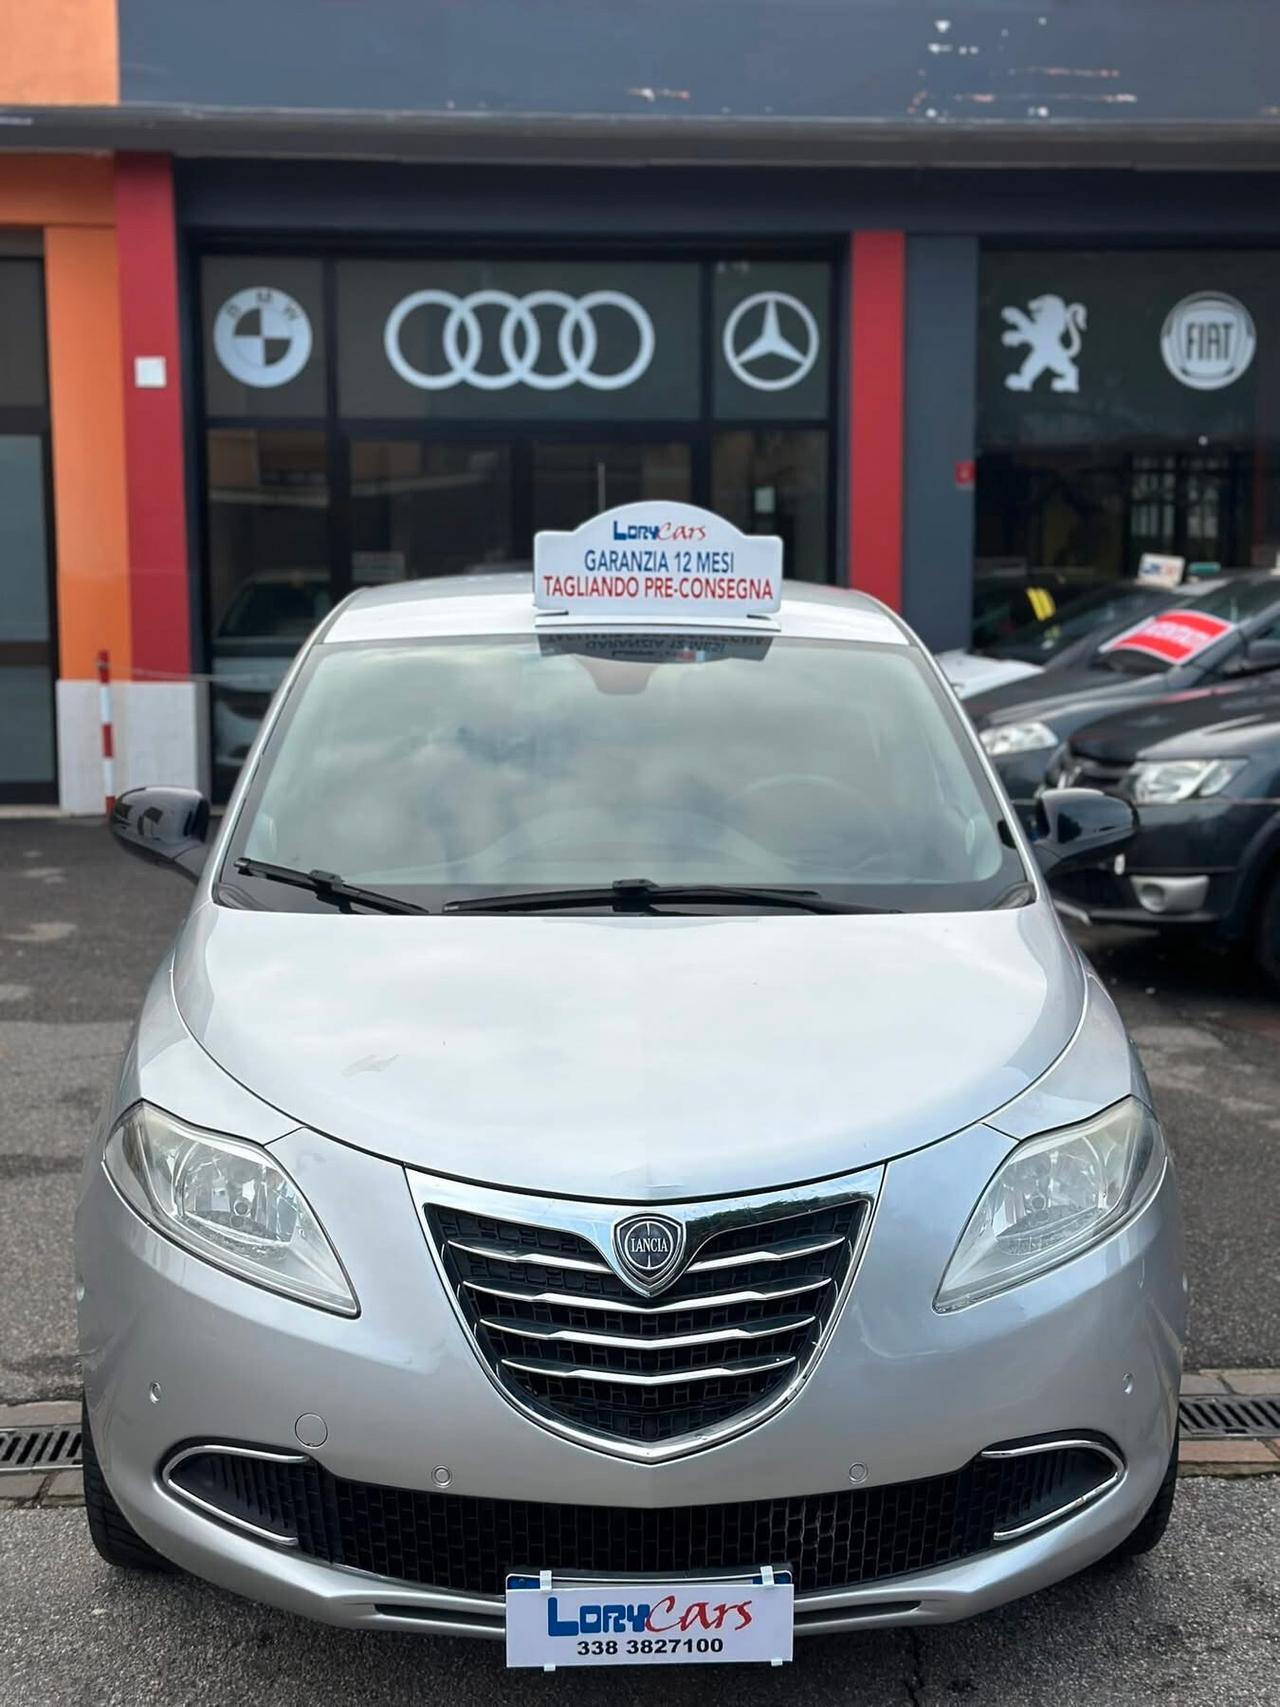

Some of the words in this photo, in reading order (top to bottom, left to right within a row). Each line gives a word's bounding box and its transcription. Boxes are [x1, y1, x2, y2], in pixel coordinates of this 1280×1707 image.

[227, 289, 301, 320] BMW
[1186, 322, 1233, 361] FIAT
[584, 550, 669, 573] GARANZIA
[674, 551, 691, 573] 12
[696, 551, 734, 573] MESI
[543, 575, 639, 598] TAGLIANDO
[645, 577, 773, 600] PRE-CONSEGNA
[631, 1238, 668, 1253] LANCIA
[577, 1639, 618, 1656] 338
[626, 1638, 724, 1655] 3827100
